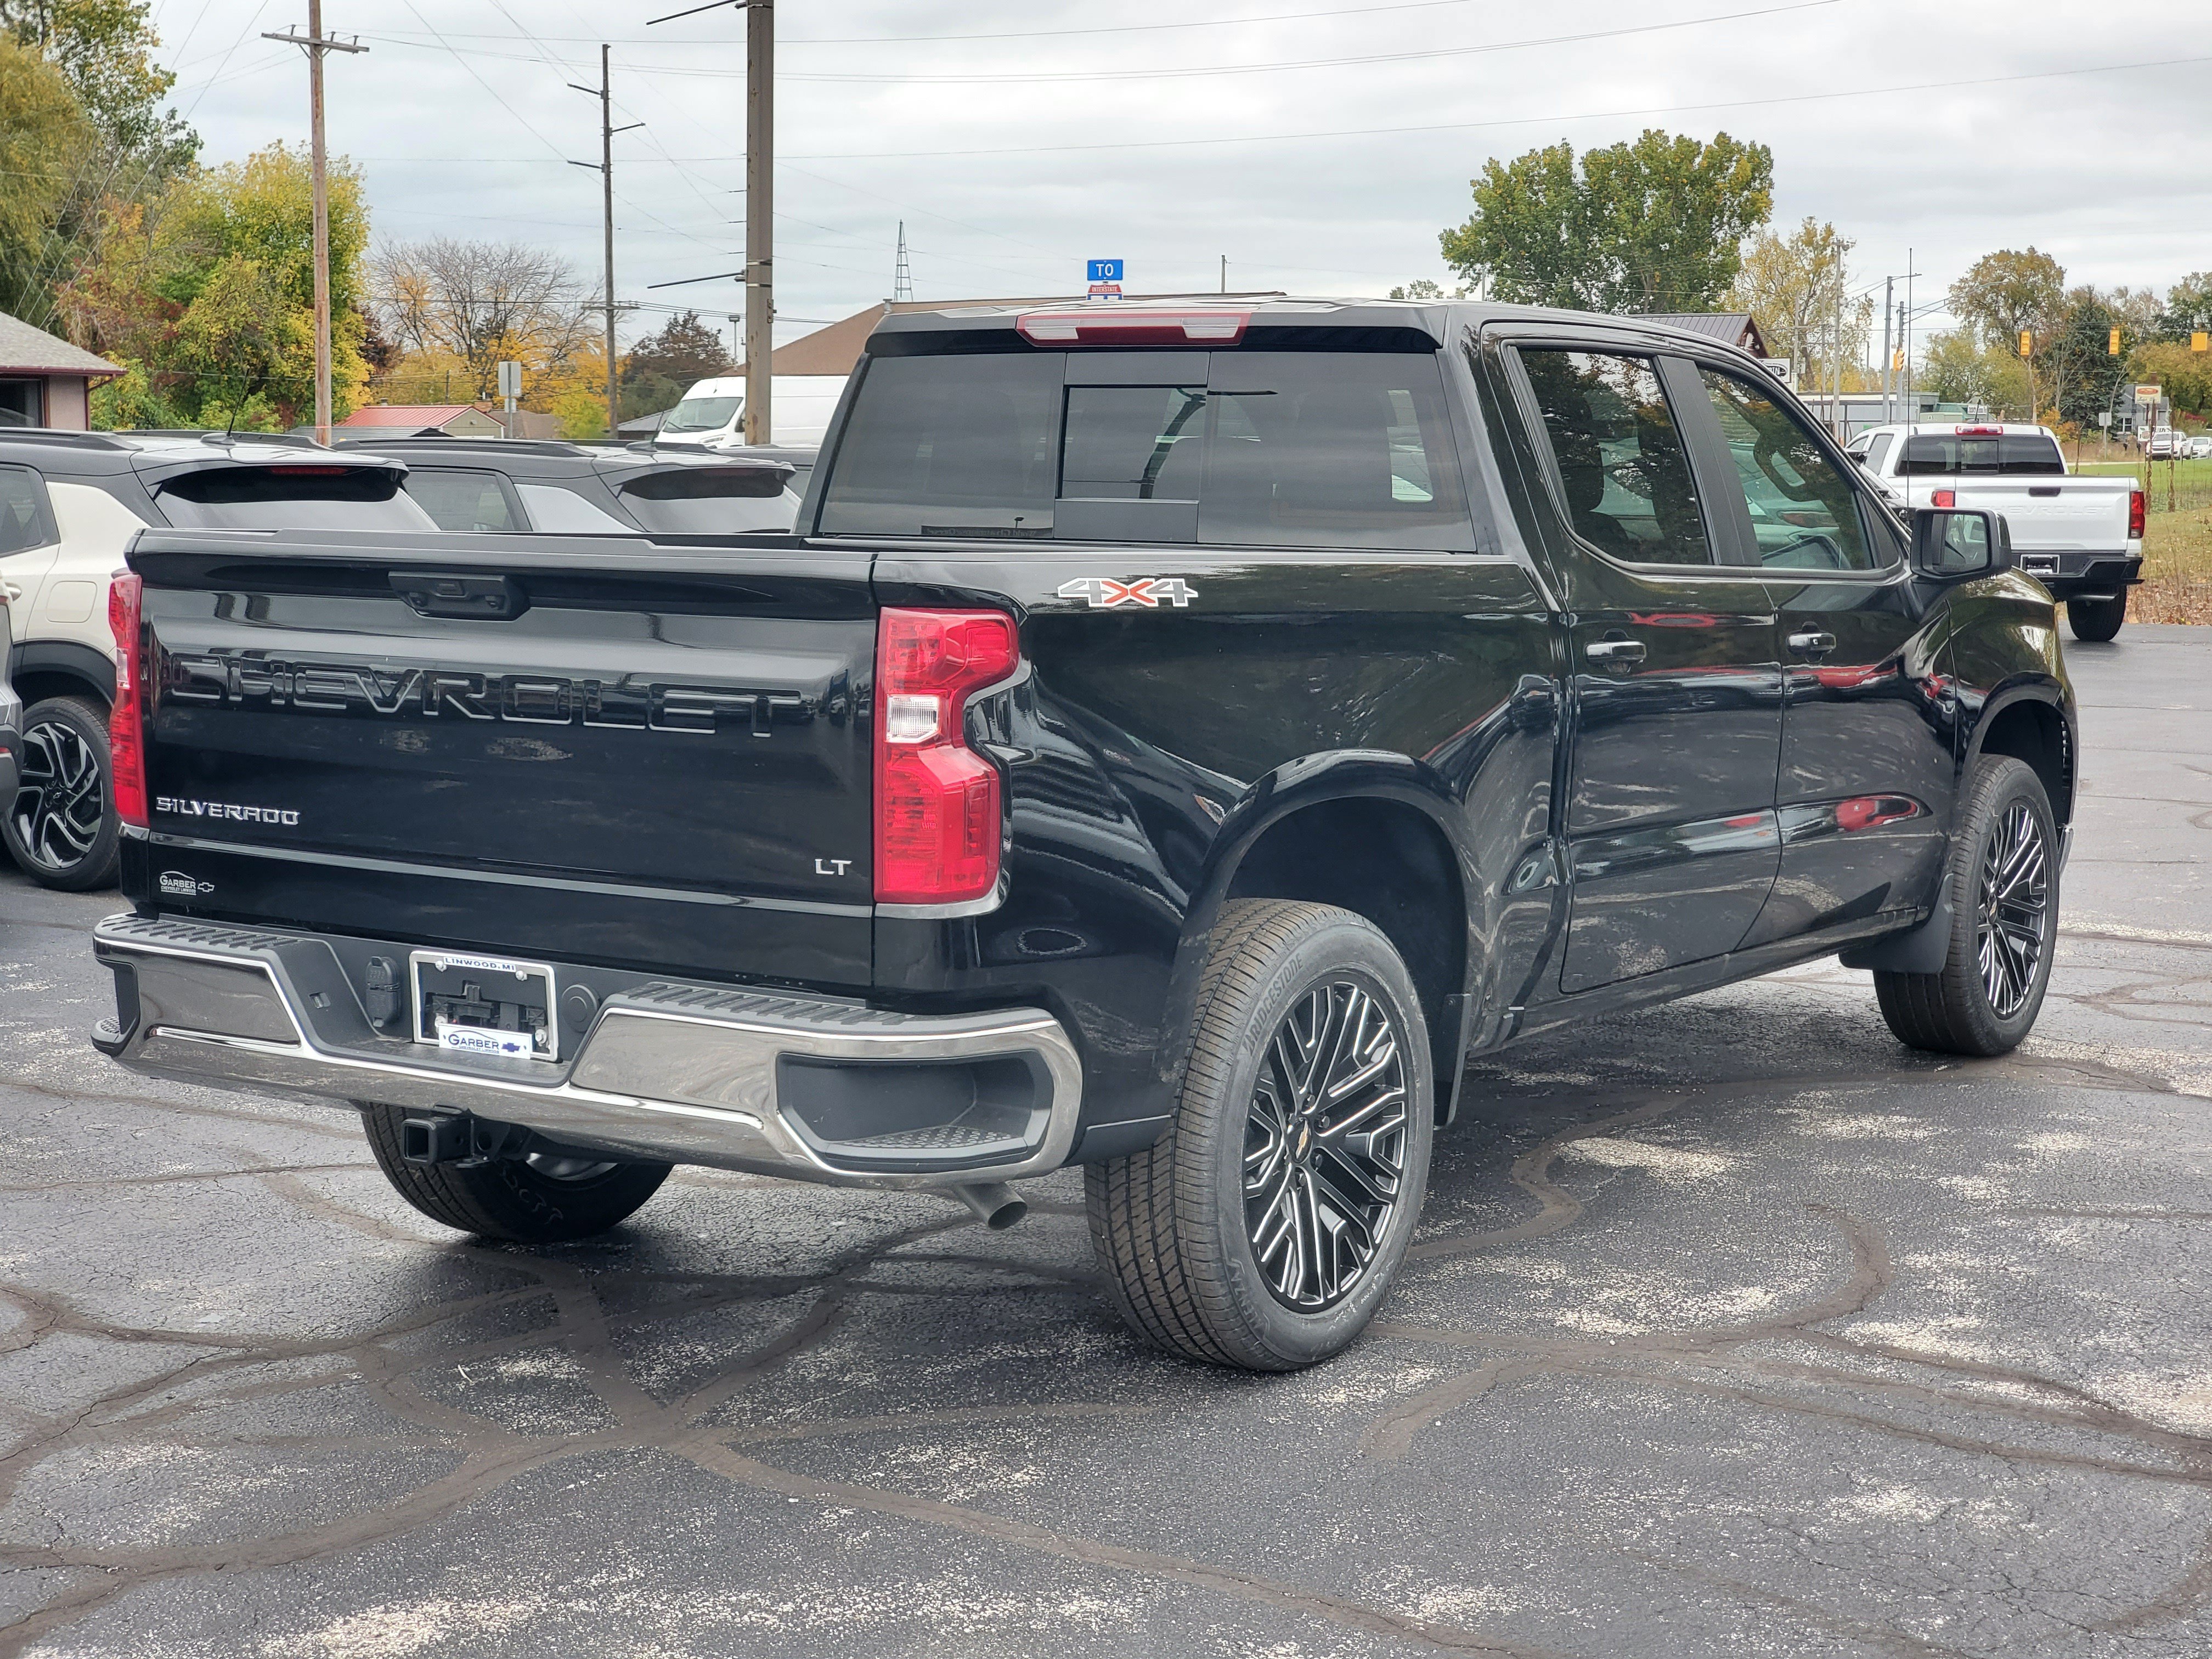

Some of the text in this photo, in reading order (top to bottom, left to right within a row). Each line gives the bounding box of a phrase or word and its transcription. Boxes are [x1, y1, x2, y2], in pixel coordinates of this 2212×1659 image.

[1096, 263, 1113, 277] TO
[169, 652, 803, 738] CHEVROLET
[156, 797, 301, 826] SILVERADO
[815, 859, 852, 876] LT
[160, 874, 196, 889] GARBER
[1242, 953, 1304, 1057] BRIDGESTONE
[448, 1034, 499, 1050] GARBER
